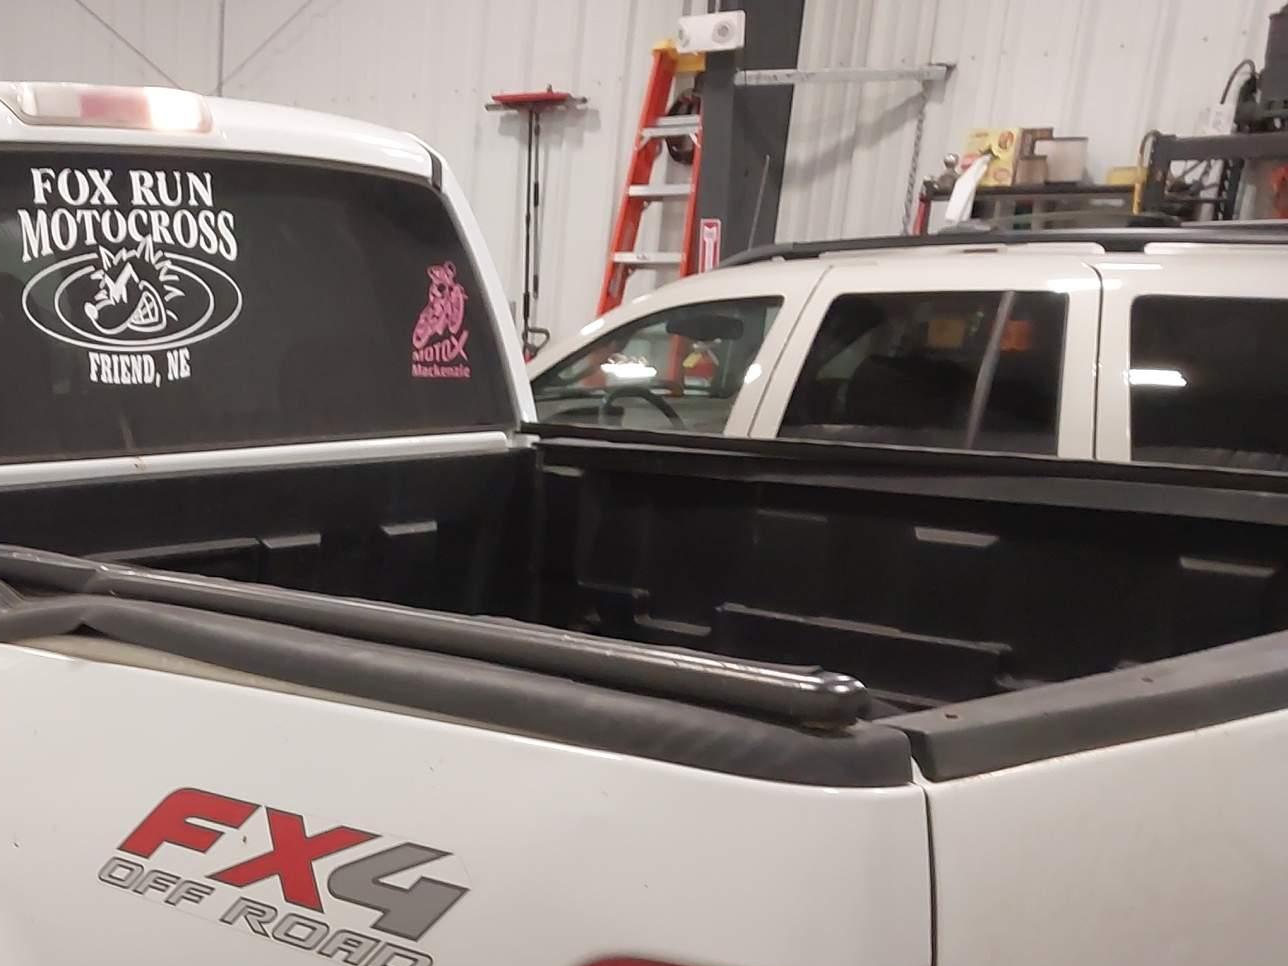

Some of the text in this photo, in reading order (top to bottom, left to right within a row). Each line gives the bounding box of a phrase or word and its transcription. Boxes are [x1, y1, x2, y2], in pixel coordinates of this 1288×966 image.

[30, 167, 214, 207] FOX RUN
[17, 208, 238, 262] MOTOCROSS
[88, 347, 192, 388] FRIEND, NE
[98, 855, 217, 907] OFF
[116, 786, 472, 943] FX4
